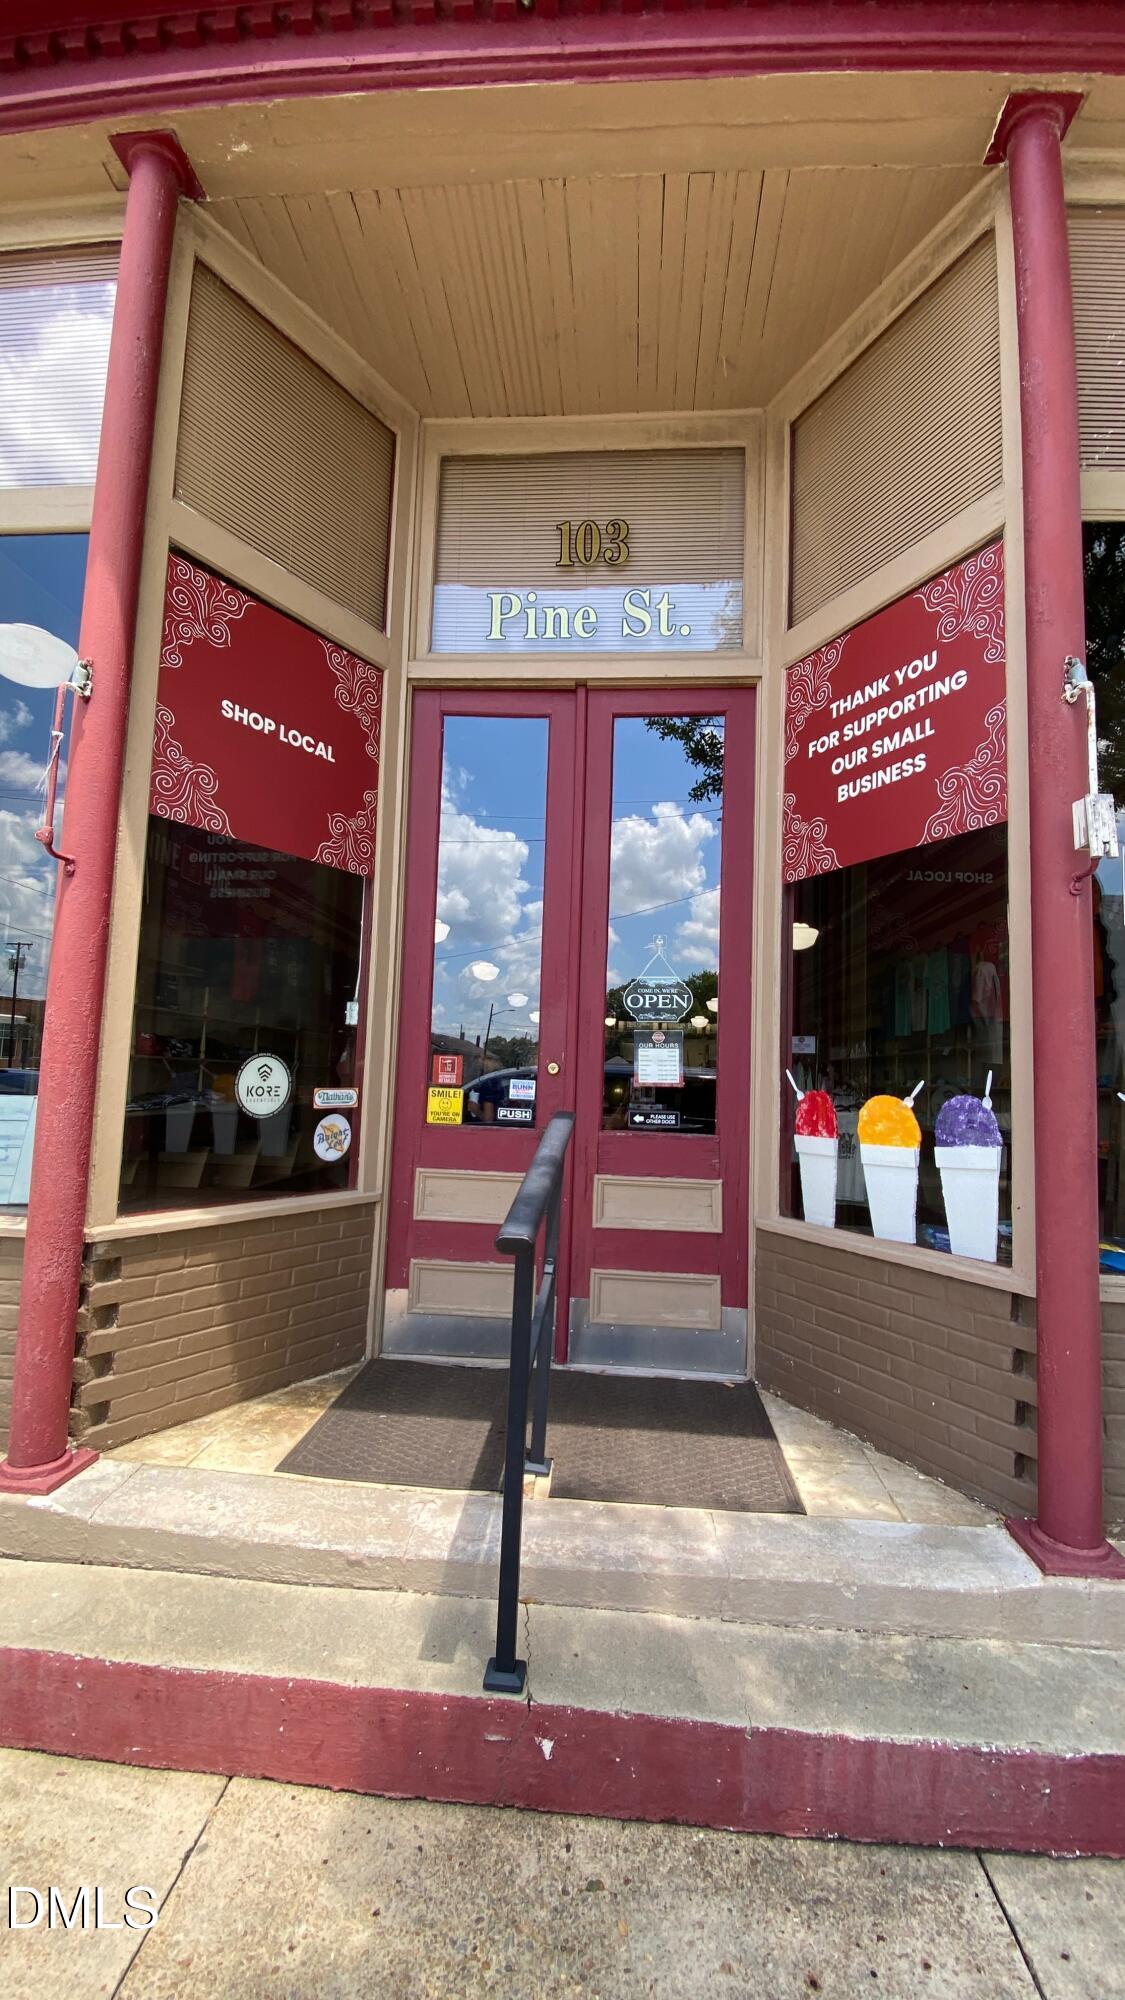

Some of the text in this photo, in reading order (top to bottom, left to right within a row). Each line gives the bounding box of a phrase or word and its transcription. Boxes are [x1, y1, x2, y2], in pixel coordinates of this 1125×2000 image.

[556, 519, 630, 567] 103
[486, 589, 692, 640] Pine St.
[830, 650, 937, 719] THANK YOU
[221, 699, 336, 763] SHOP LOCAL
[808, 669, 968, 759] FOR SUPPORTING
[831, 718, 935, 775] OUR SMALL
[837, 753, 927, 803] BUSINESS
[627, 994, 689, 1008] OPEN
[246, 1085, 281, 1098] KORE
[431, 1089, 461, 1098] SMILE!
[500, 1110, 530, 1119] PUSH
